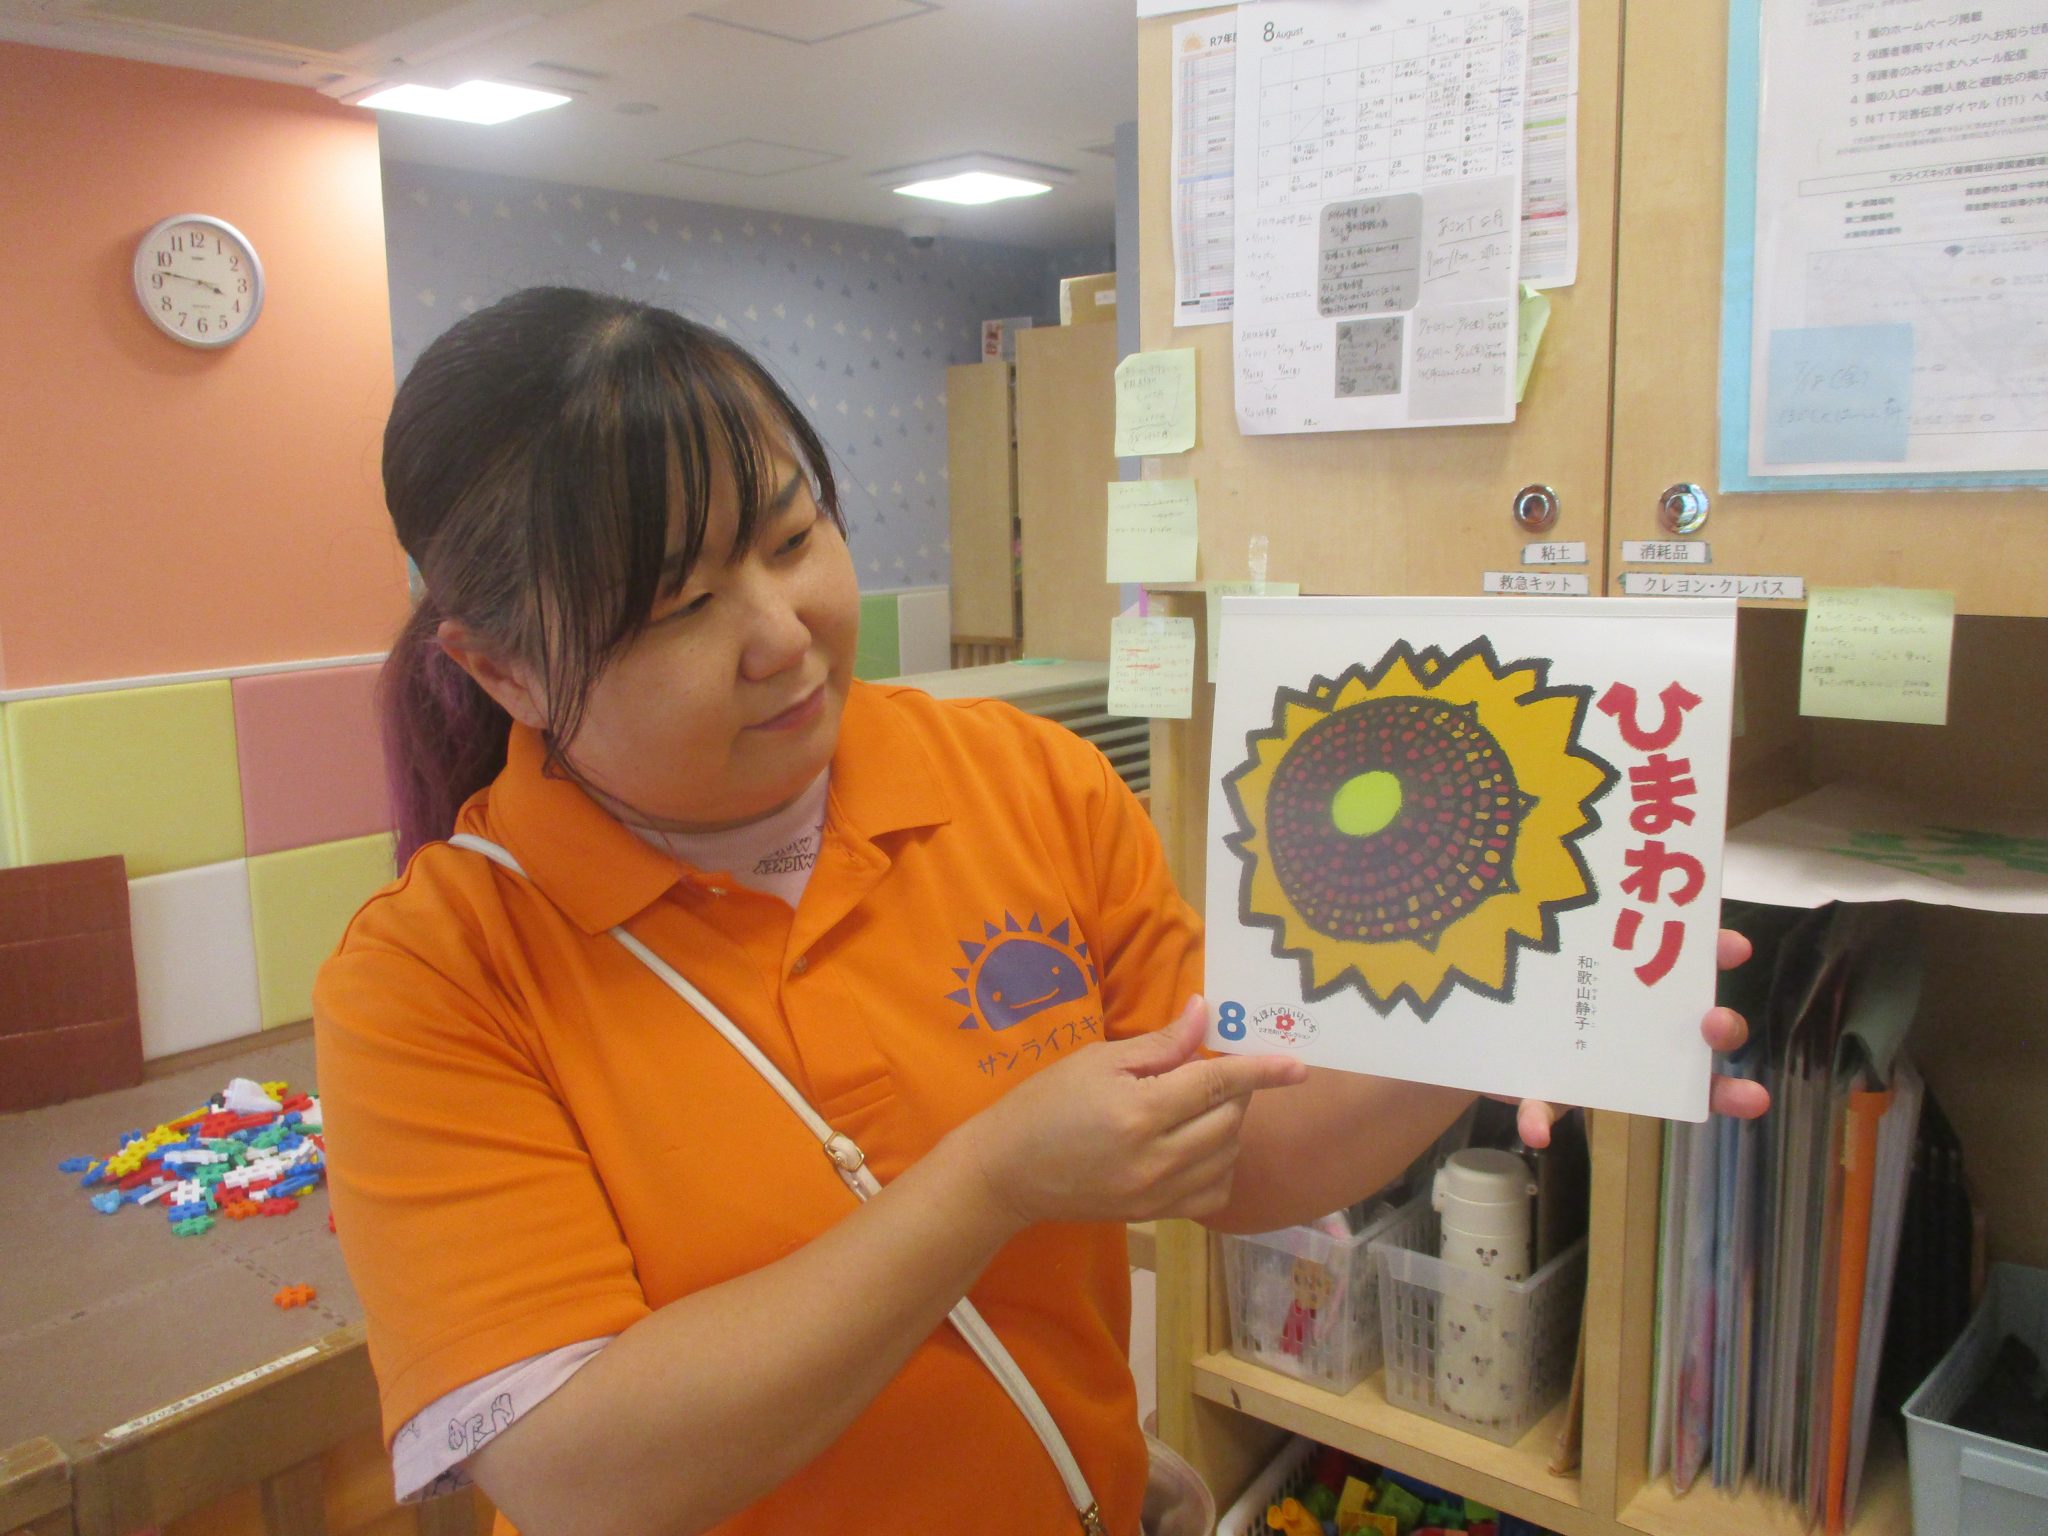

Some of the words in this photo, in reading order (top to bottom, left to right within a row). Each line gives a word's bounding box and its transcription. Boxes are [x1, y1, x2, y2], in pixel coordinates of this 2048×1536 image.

[1263, 21, 1275, 42] 8
[1276, 27, 1304, 40] August
[1852, 52, 1860, 62] 2
[1851, 73, 1859, 84] 3
[1850, 95, 1858, 104] 4
[1850, 116, 1858, 127] 5
[171, 236, 183, 252] 11
[190, 232, 204, 248] 12
[217, 239, 222, 255] 1
[157, 251, 172, 268] 10
[229, 255, 239, 272] 2
[152, 273, 163, 289] 9
[237, 278, 247, 294] 3
[161, 296, 172, 312] 8
[233, 299, 240, 313] 4
[178, 312, 187, 327] 7
[197, 317, 208, 333] 6
[219, 315, 228, 330] 5
[1541, 546, 1570, 561] 粘土
[1640, 544, 1689, 561] 消耗品
[1499, 574, 1572, 592] 救急キット
[1596, 681, 1704, 987] ひまわり
[1575, 955, 1593, 1031] 和歌山静子
[1217, 1001, 1246, 1041] 8
[1576, 1039, 1588, 1050] 作
